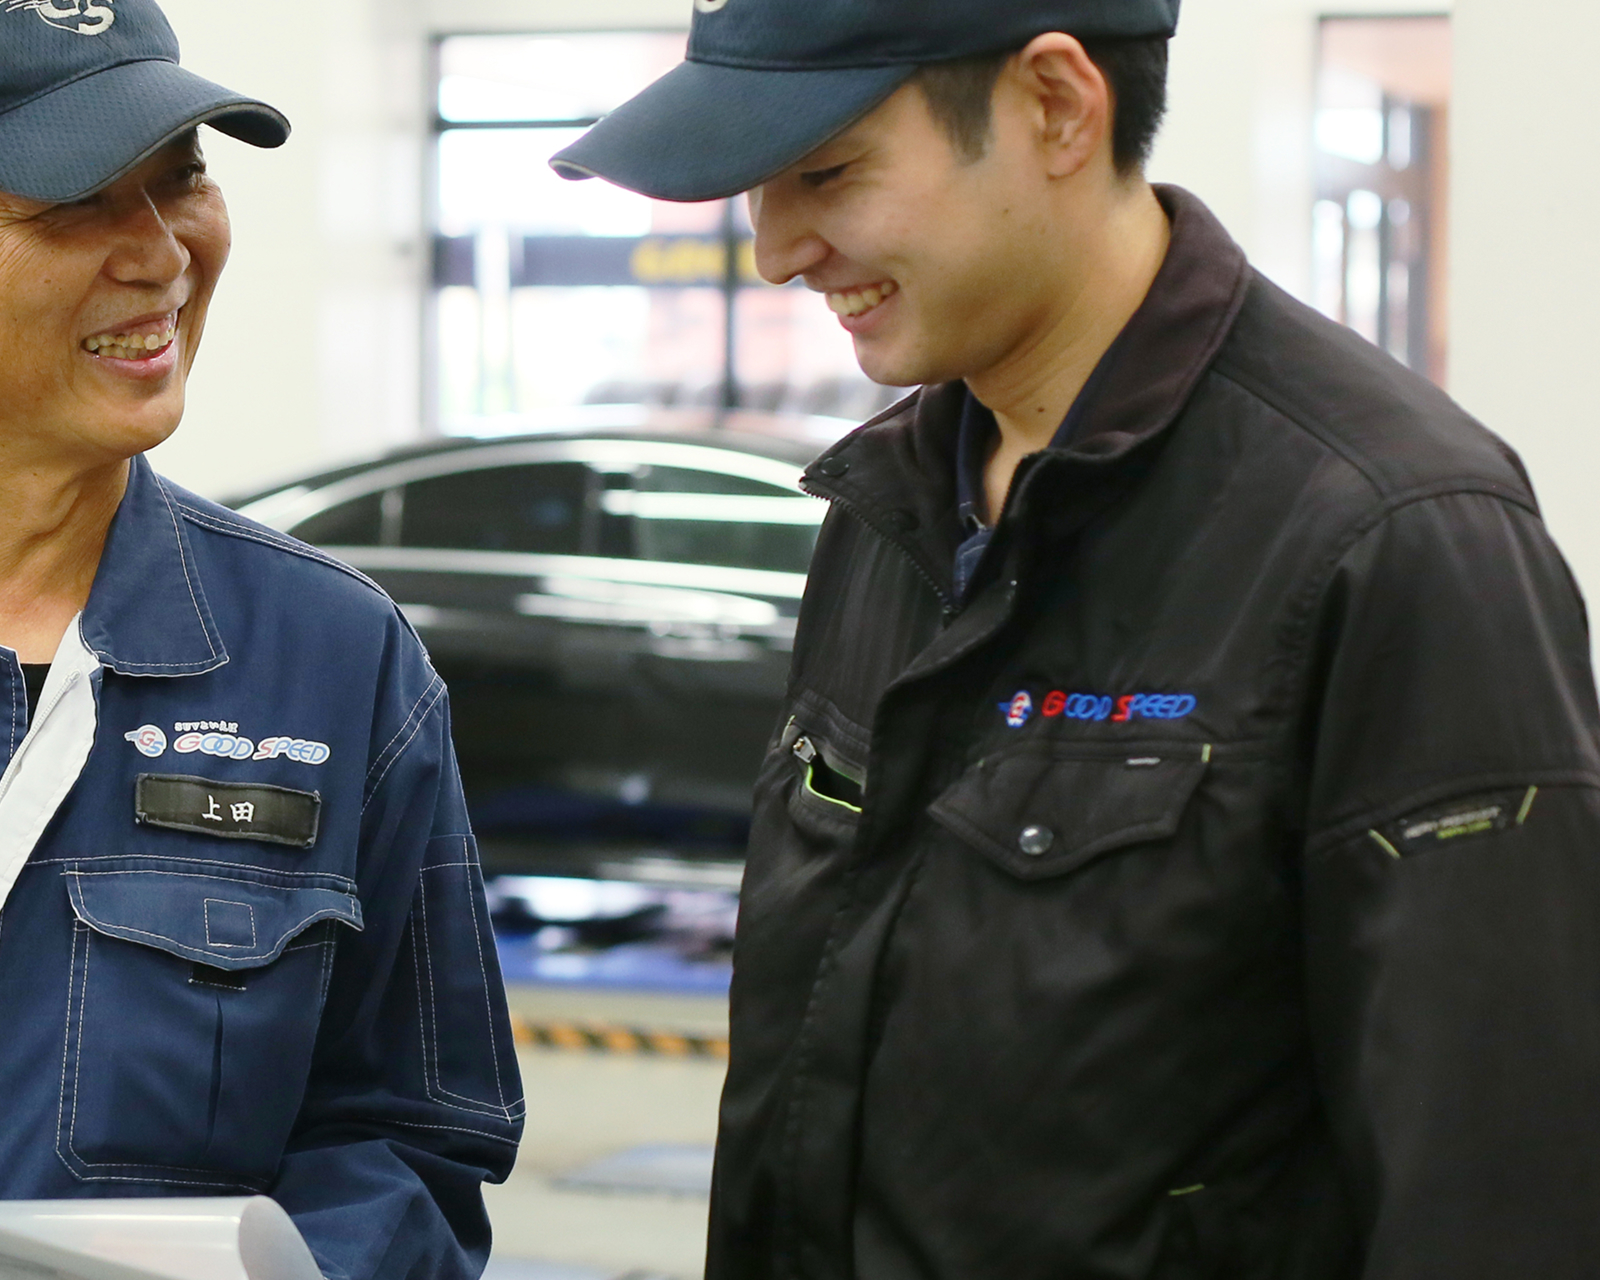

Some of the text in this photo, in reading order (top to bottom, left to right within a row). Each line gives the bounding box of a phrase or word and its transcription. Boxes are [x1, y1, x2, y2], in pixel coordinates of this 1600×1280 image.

[1041, 690, 1197, 722] GOOD SPEED
[175, 733, 329, 764] GOOD SPEED
[202, 794, 255, 823] 上田
